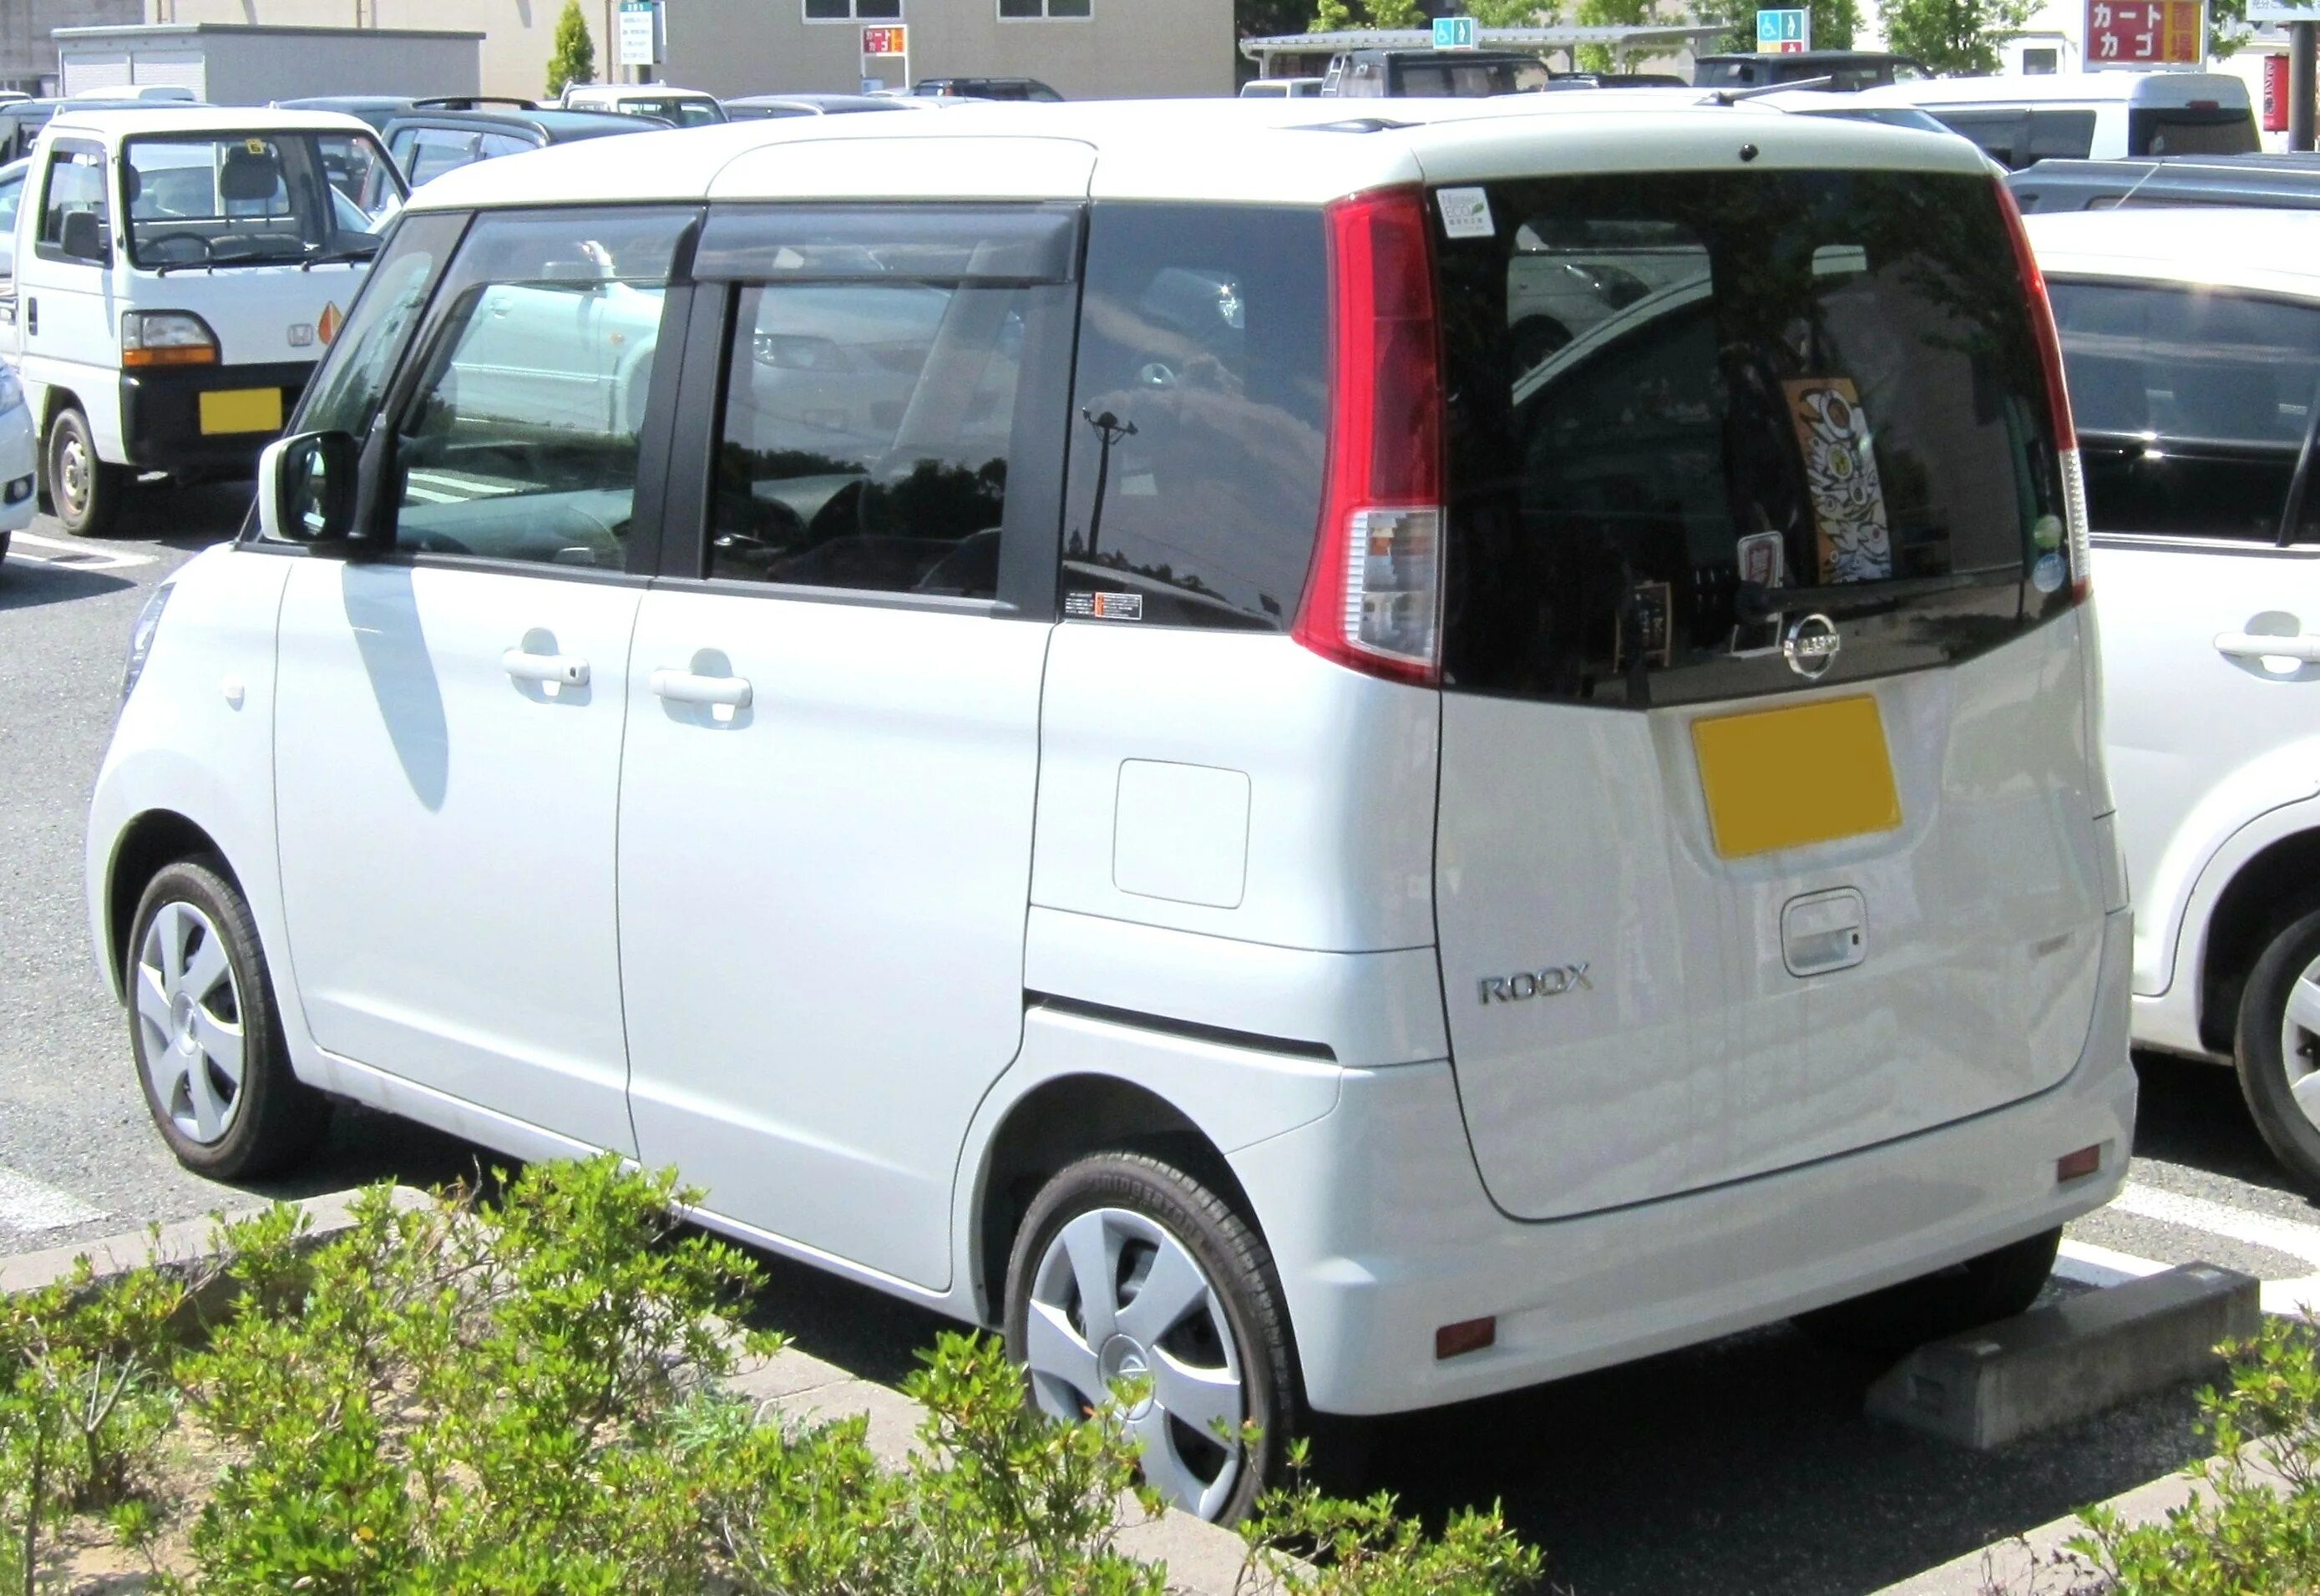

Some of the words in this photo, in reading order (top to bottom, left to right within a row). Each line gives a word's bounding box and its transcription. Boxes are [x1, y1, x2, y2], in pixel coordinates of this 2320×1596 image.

[2094, 3, 2161, 29] カート
[2100, 32, 2153, 57] カゴ
[1477, 962, 1592, 1005] ROOX
